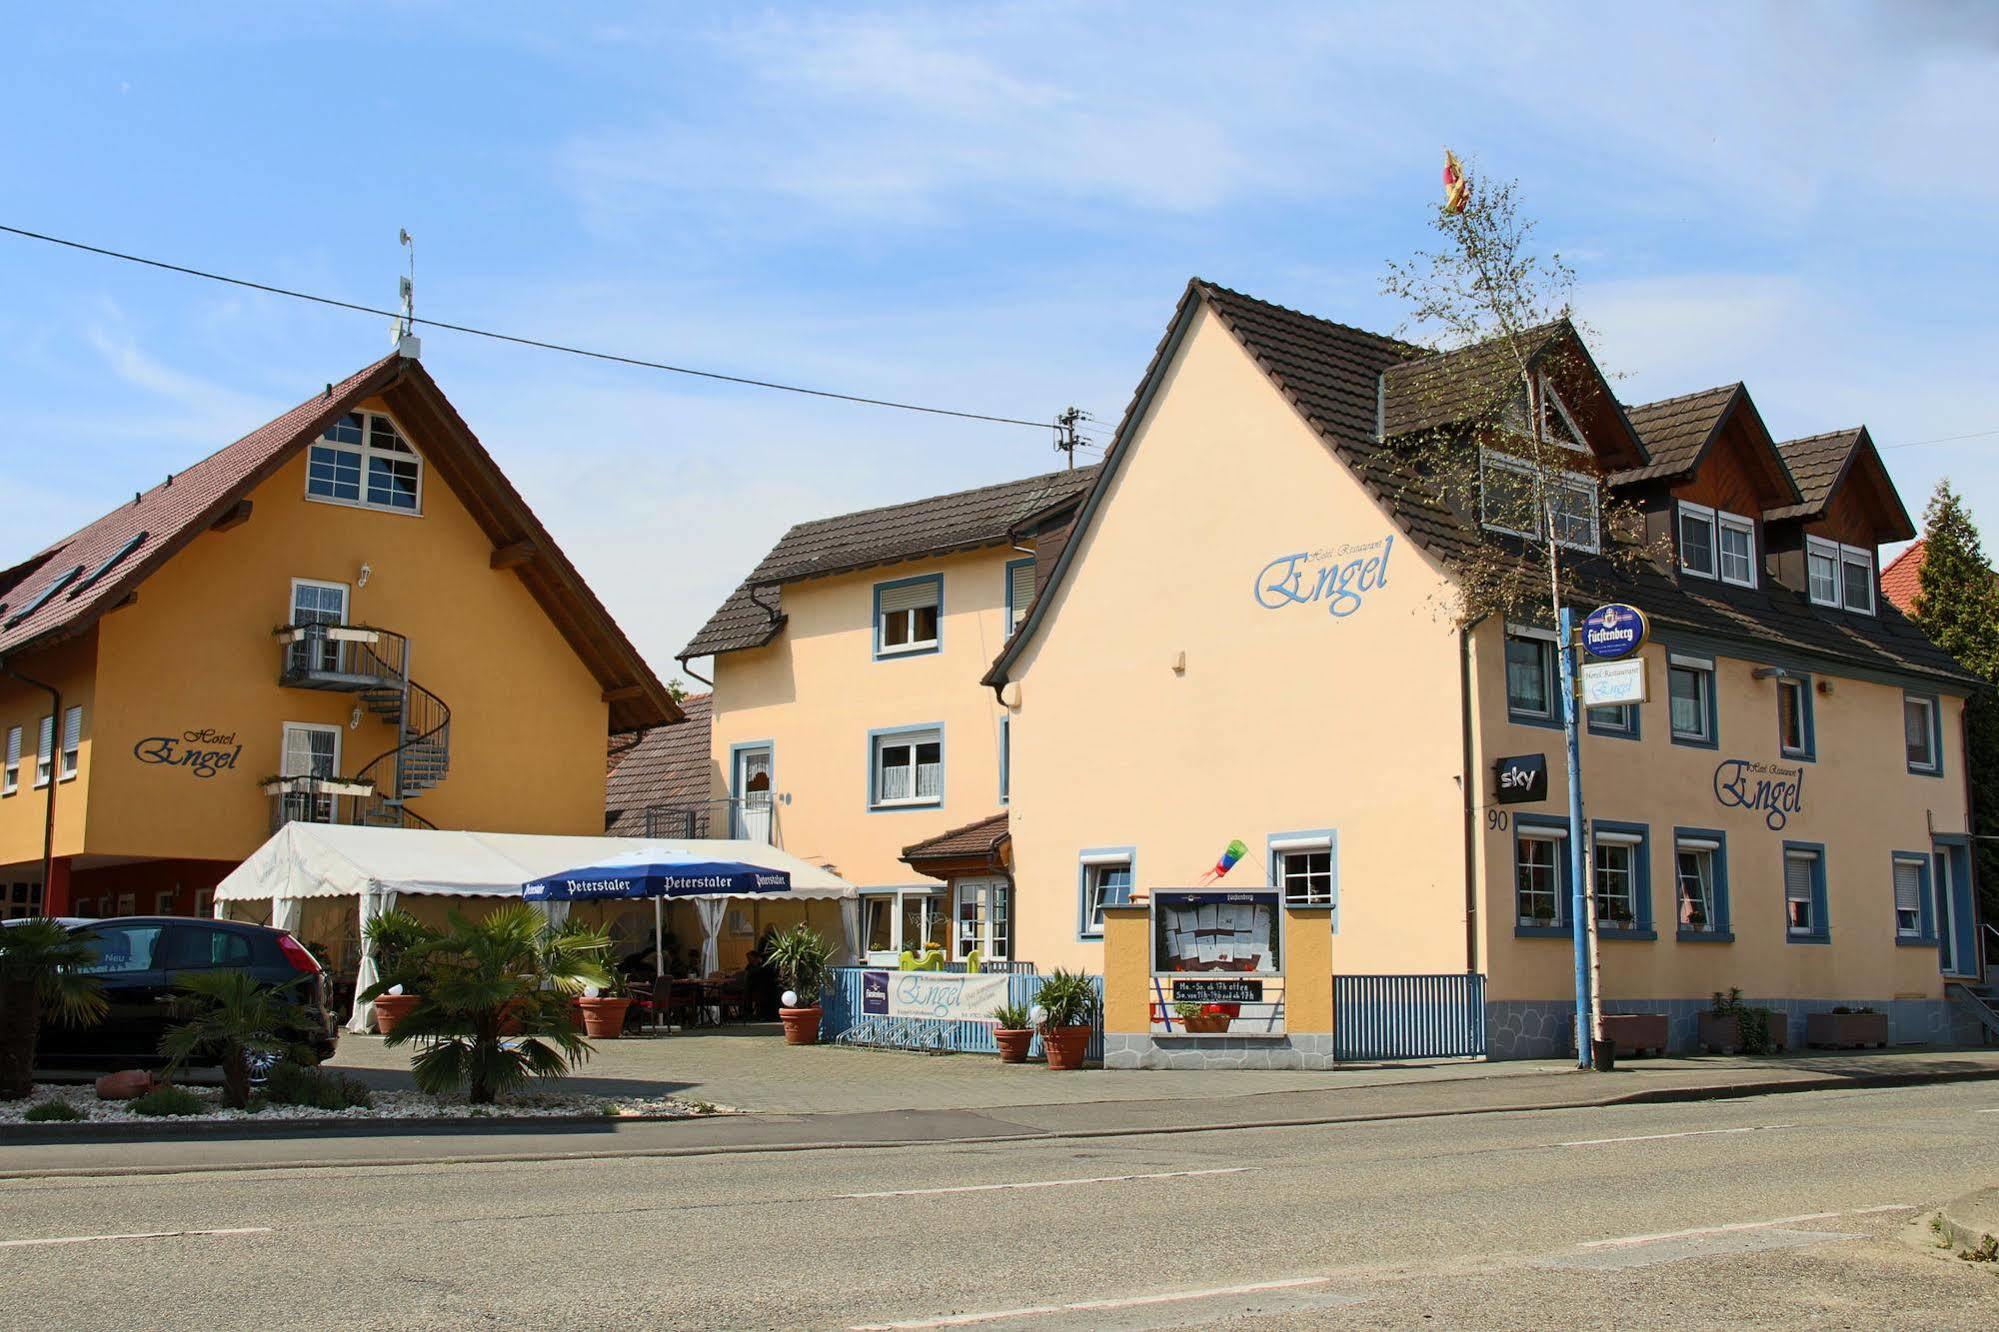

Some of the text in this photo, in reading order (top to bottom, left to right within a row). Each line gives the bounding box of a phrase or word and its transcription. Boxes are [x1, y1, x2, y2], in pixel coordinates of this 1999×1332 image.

[1254, 534, 1394, 617] Engel
[184, 728, 236, 745] Hotel
[134, 737, 243, 778] Engel
[1501, 766, 1536, 791] sky
[1714, 760, 1803, 831] Engel
[1488, 809, 1508, 832] 90
[567, 879, 631, 895] Peterstaler
[664, 875, 733, 891] Peterstaler
[755, 873, 785, 887] Peterstaler
[896, 975, 965, 1018] Engel
